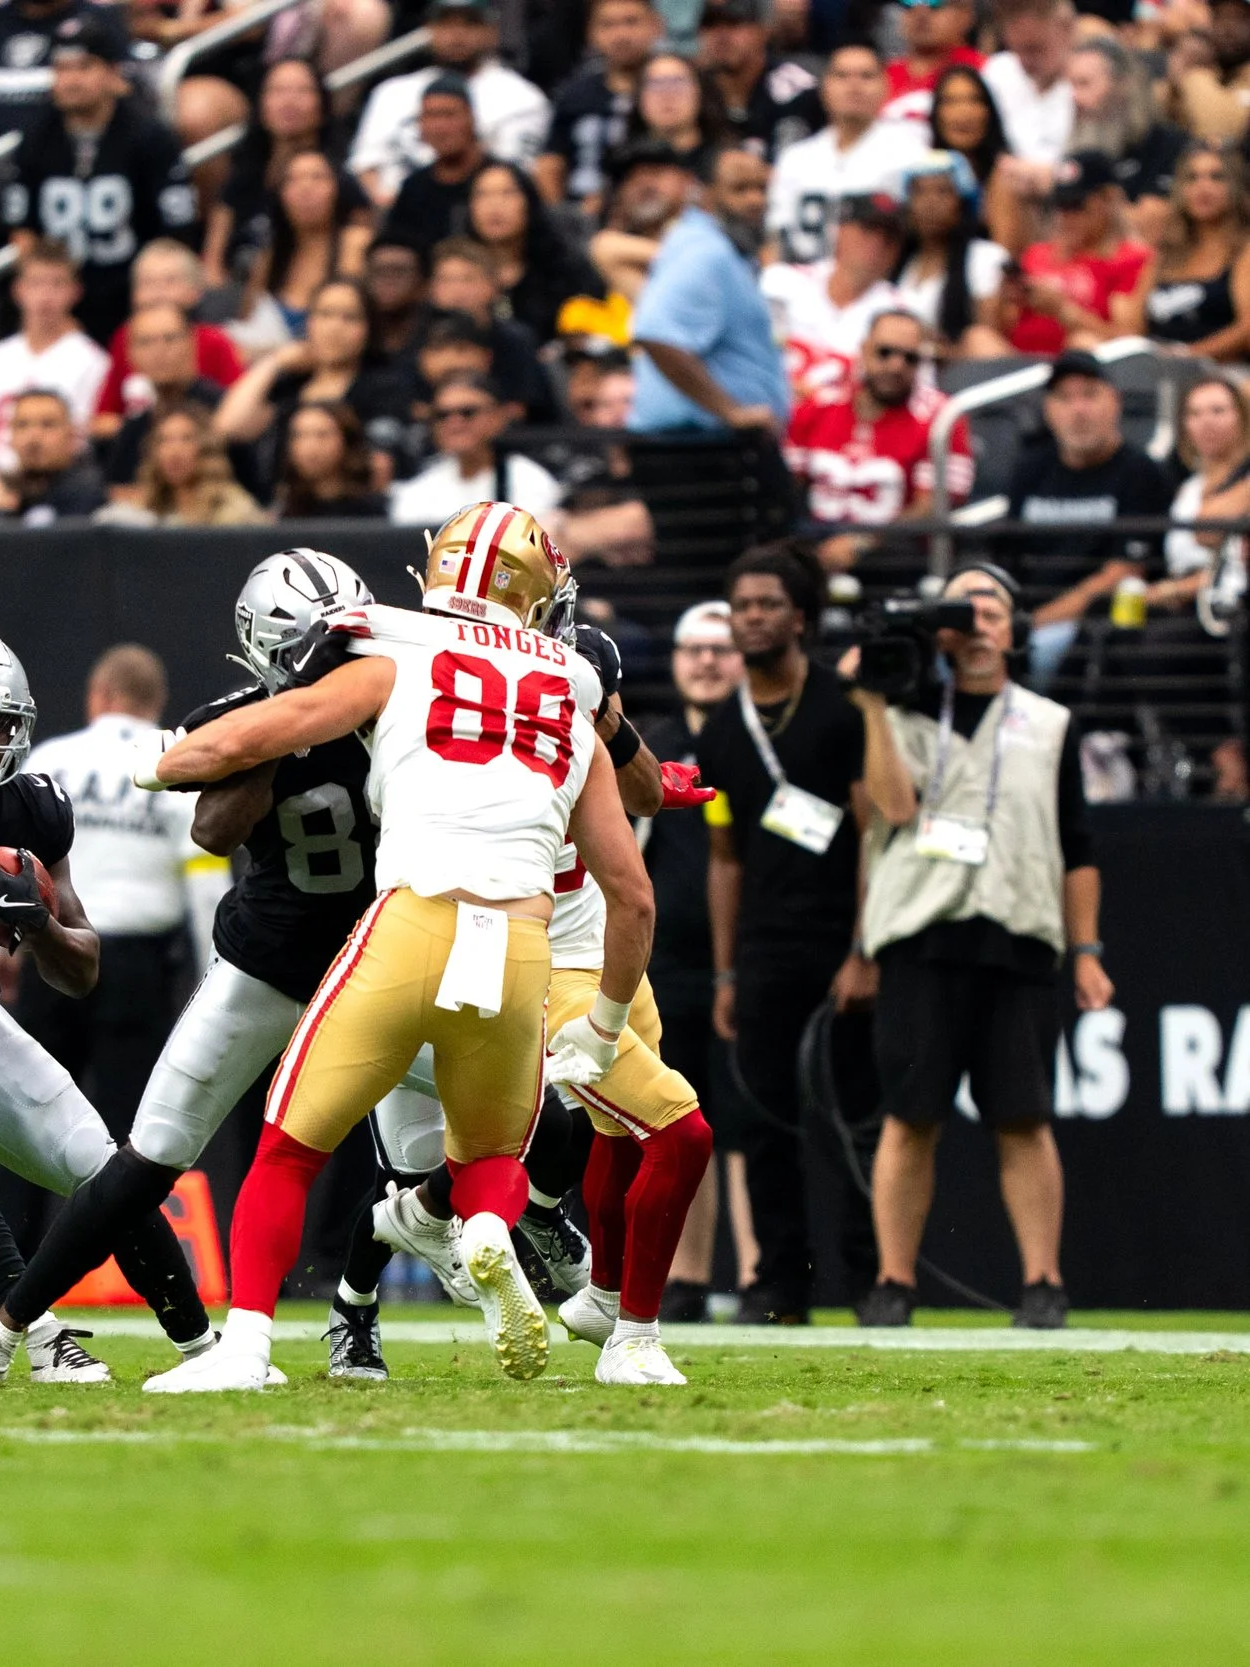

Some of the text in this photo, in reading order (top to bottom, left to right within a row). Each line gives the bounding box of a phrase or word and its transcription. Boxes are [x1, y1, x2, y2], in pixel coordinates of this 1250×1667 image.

[320, 605, 346, 619] RAIDERS
[452, 621, 568, 668] TONGES
[425, 648, 577, 791] 88
[276, 780, 382, 895] 8
